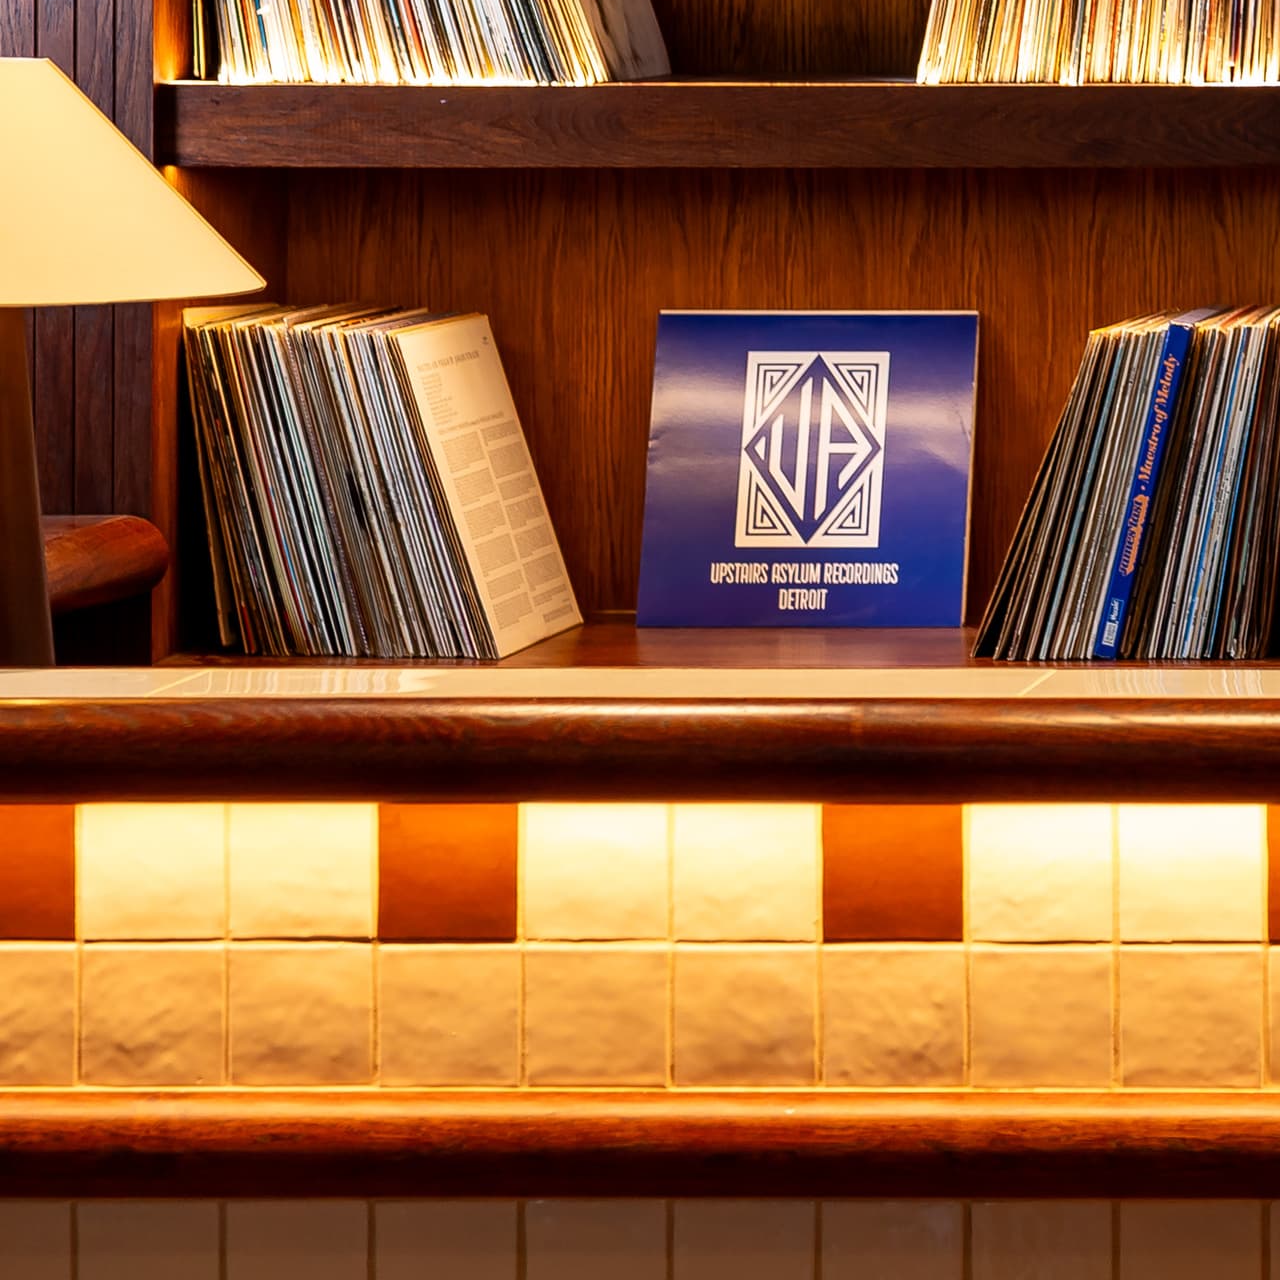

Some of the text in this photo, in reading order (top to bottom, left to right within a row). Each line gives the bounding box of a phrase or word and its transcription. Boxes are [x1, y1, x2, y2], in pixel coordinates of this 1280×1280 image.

[1155, 353, 1181, 408] Melody
[1153, 404, 1169, 423] of
[1137, 424, 1163, 484] Maestro
[710, 562, 900, 584] UPSTAIRS ASYLUM RECORDINGS
[778, 588, 828, 611] DETROIT
